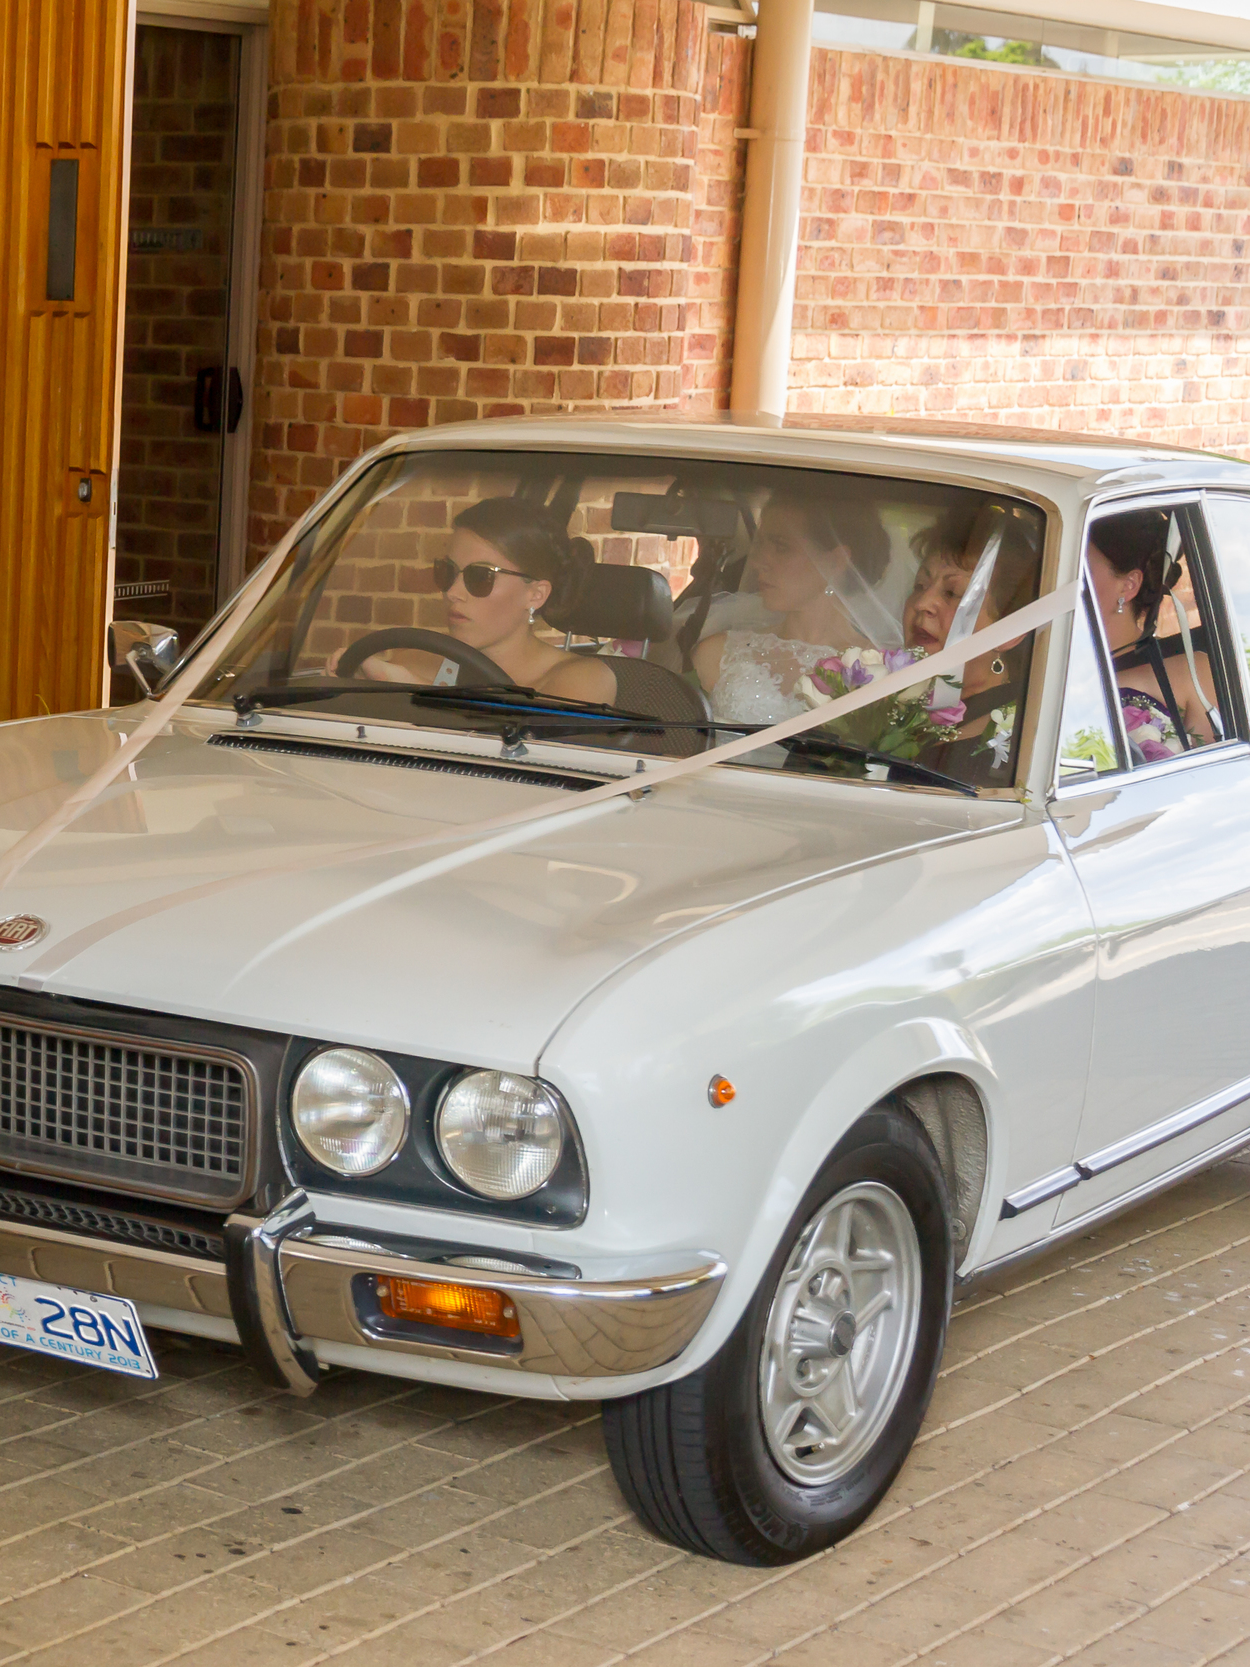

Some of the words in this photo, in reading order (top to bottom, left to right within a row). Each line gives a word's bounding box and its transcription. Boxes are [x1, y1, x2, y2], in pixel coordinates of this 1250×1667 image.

[1, 1327, 19, 1340] OF
[25, 1333, 35, 1344] A
[39, 1336, 102, 1361] CENTURY
[108, 1353, 141, 1370] 2013
[34, 1295, 143, 1358] 28N
